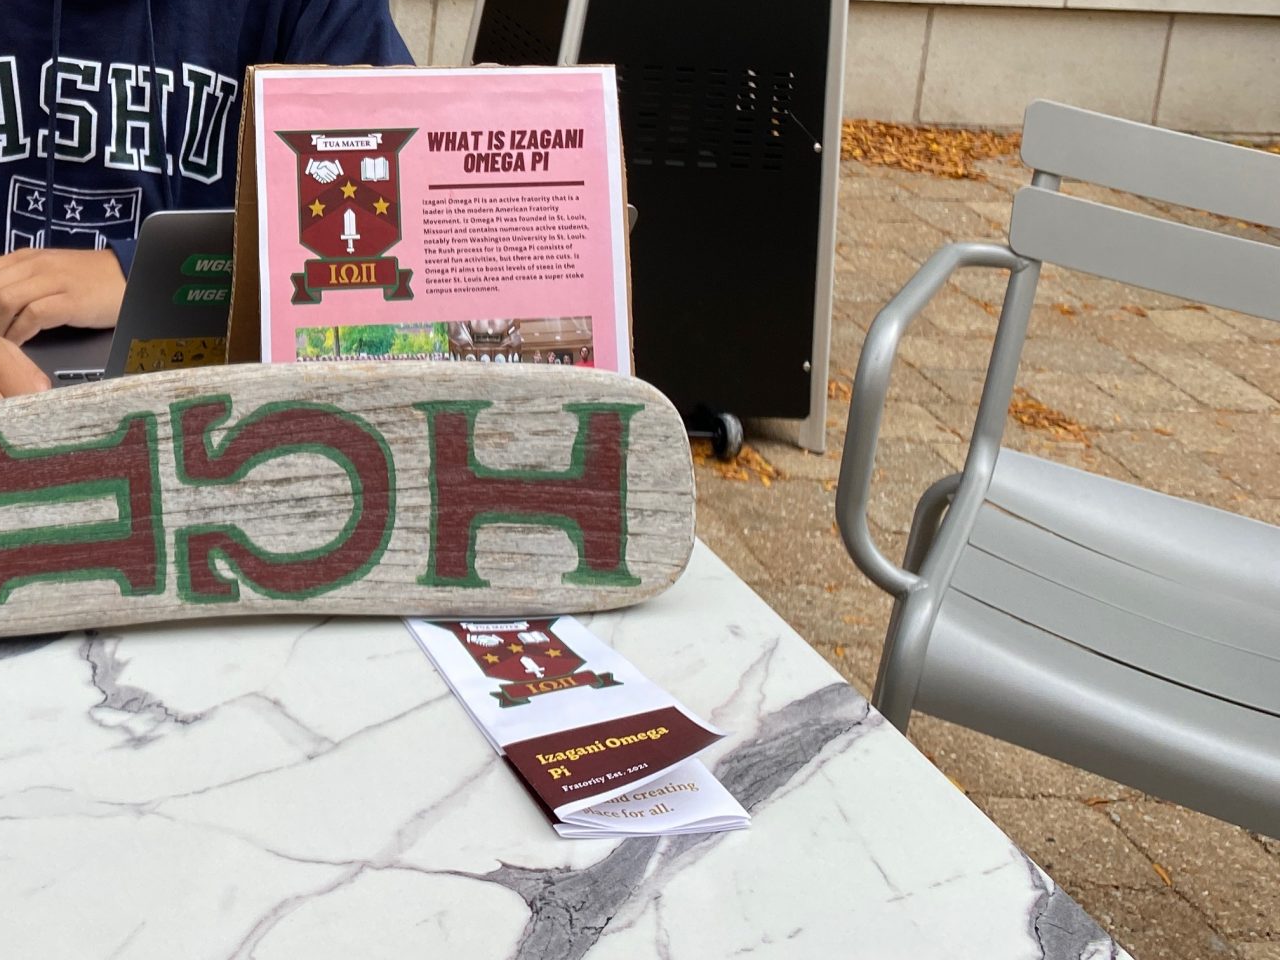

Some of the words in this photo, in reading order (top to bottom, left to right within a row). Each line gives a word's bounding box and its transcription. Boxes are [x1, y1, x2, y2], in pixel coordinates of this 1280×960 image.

[322, 139, 340, 148] TUA
[341, 138, 371, 148] MATER
[427, 130, 483, 152] WHAT
[487, 130, 505, 150] IS
[509, 128, 584, 150] IZAGANI
[463, 152, 526, 173] OMEGA
[530, 151, 549, 171] PI
[424, 237, 449, 245] notably
[470, 236, 510, 244] Washington
[504, 245, 527, 253] Omega
[425, 267, 449, 275] Omega
[187, 289, 228, 301] WGE
[536, 740, 606, 765] Izagani
[605, 726, 669, 747] Omega
[548, 765, 572, 780] Pi
[562, 776, 605, 793] Fratority
[627, 763, 648, 773] 2021
[633, 781, 699, 800] creating
[622, 809, 645, 819] for
[651, 803, 674, 815] all.
